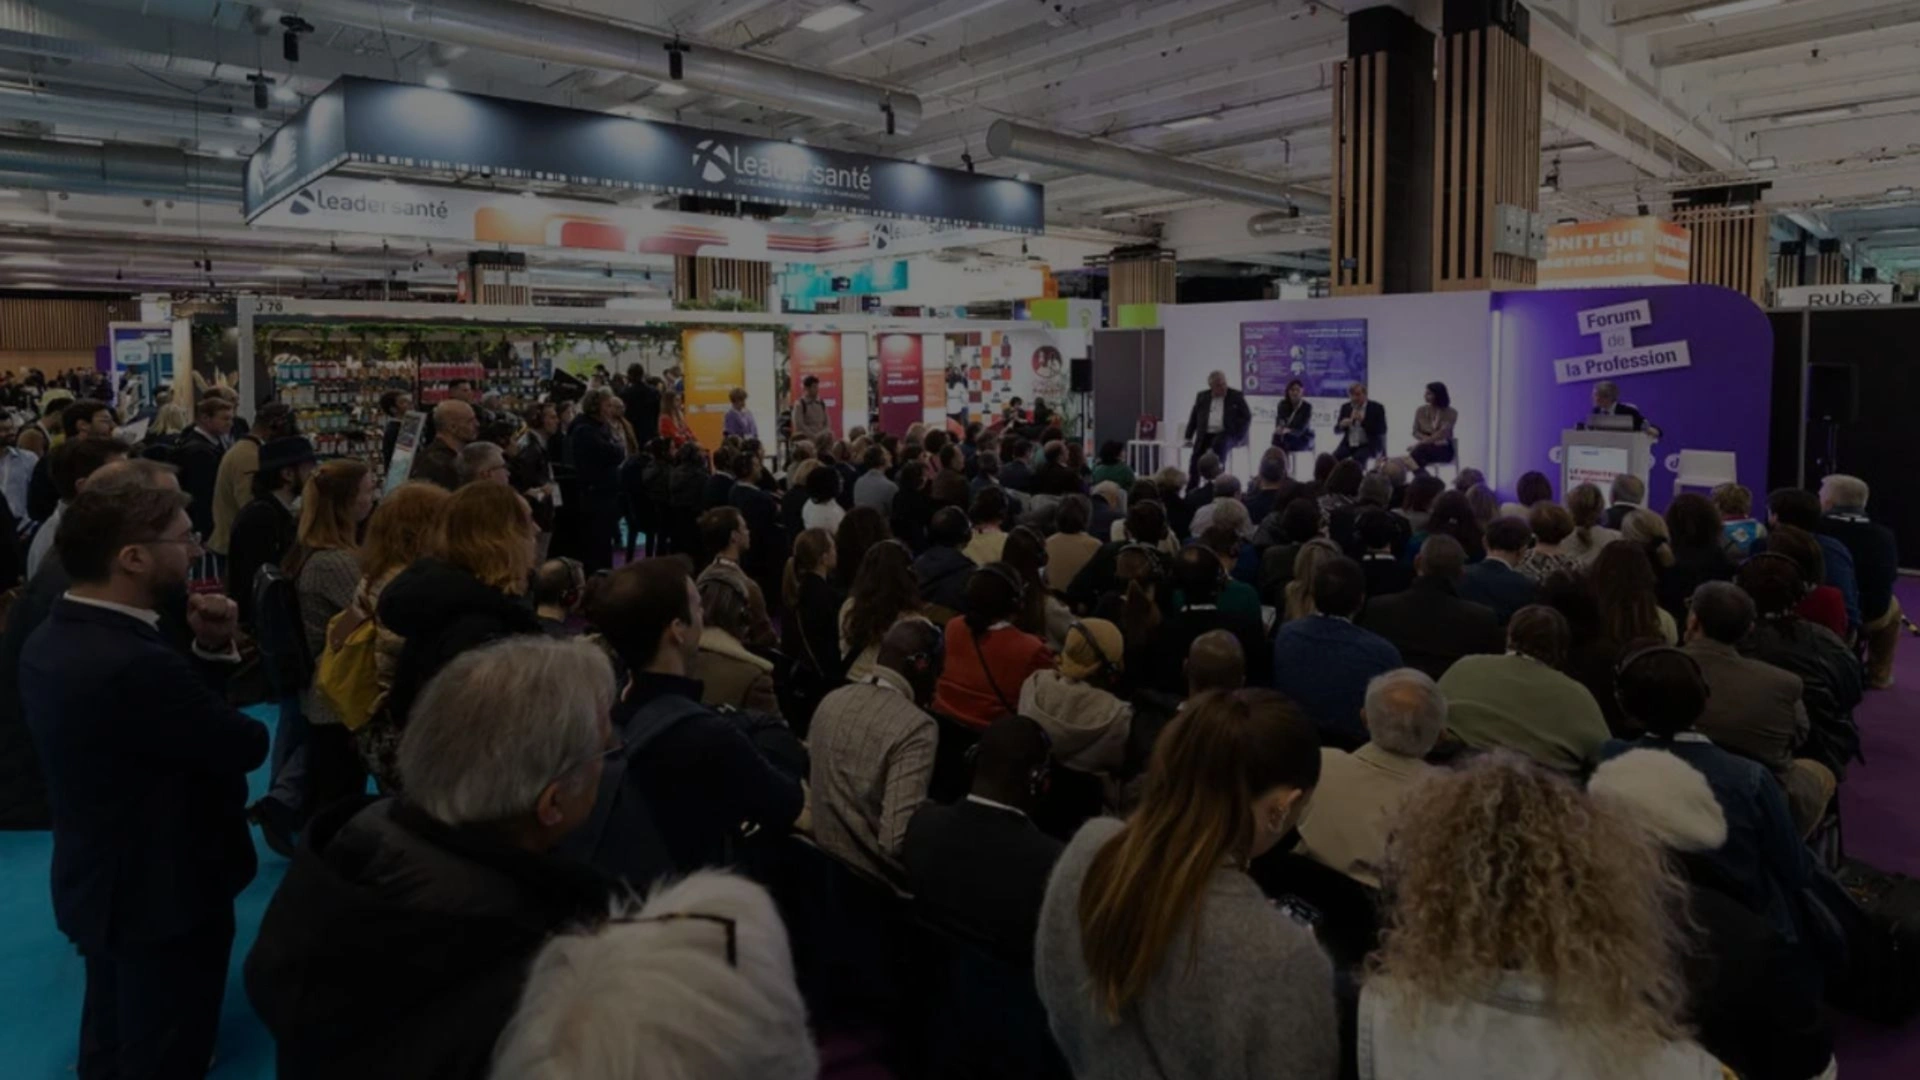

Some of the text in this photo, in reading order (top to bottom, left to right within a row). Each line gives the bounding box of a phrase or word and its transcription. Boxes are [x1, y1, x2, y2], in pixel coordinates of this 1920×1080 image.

[1587, 308, 1642, 329] Forum
[1607, 333, 1626, 348] de
[1565, 350, 1678, 377] la Profession
